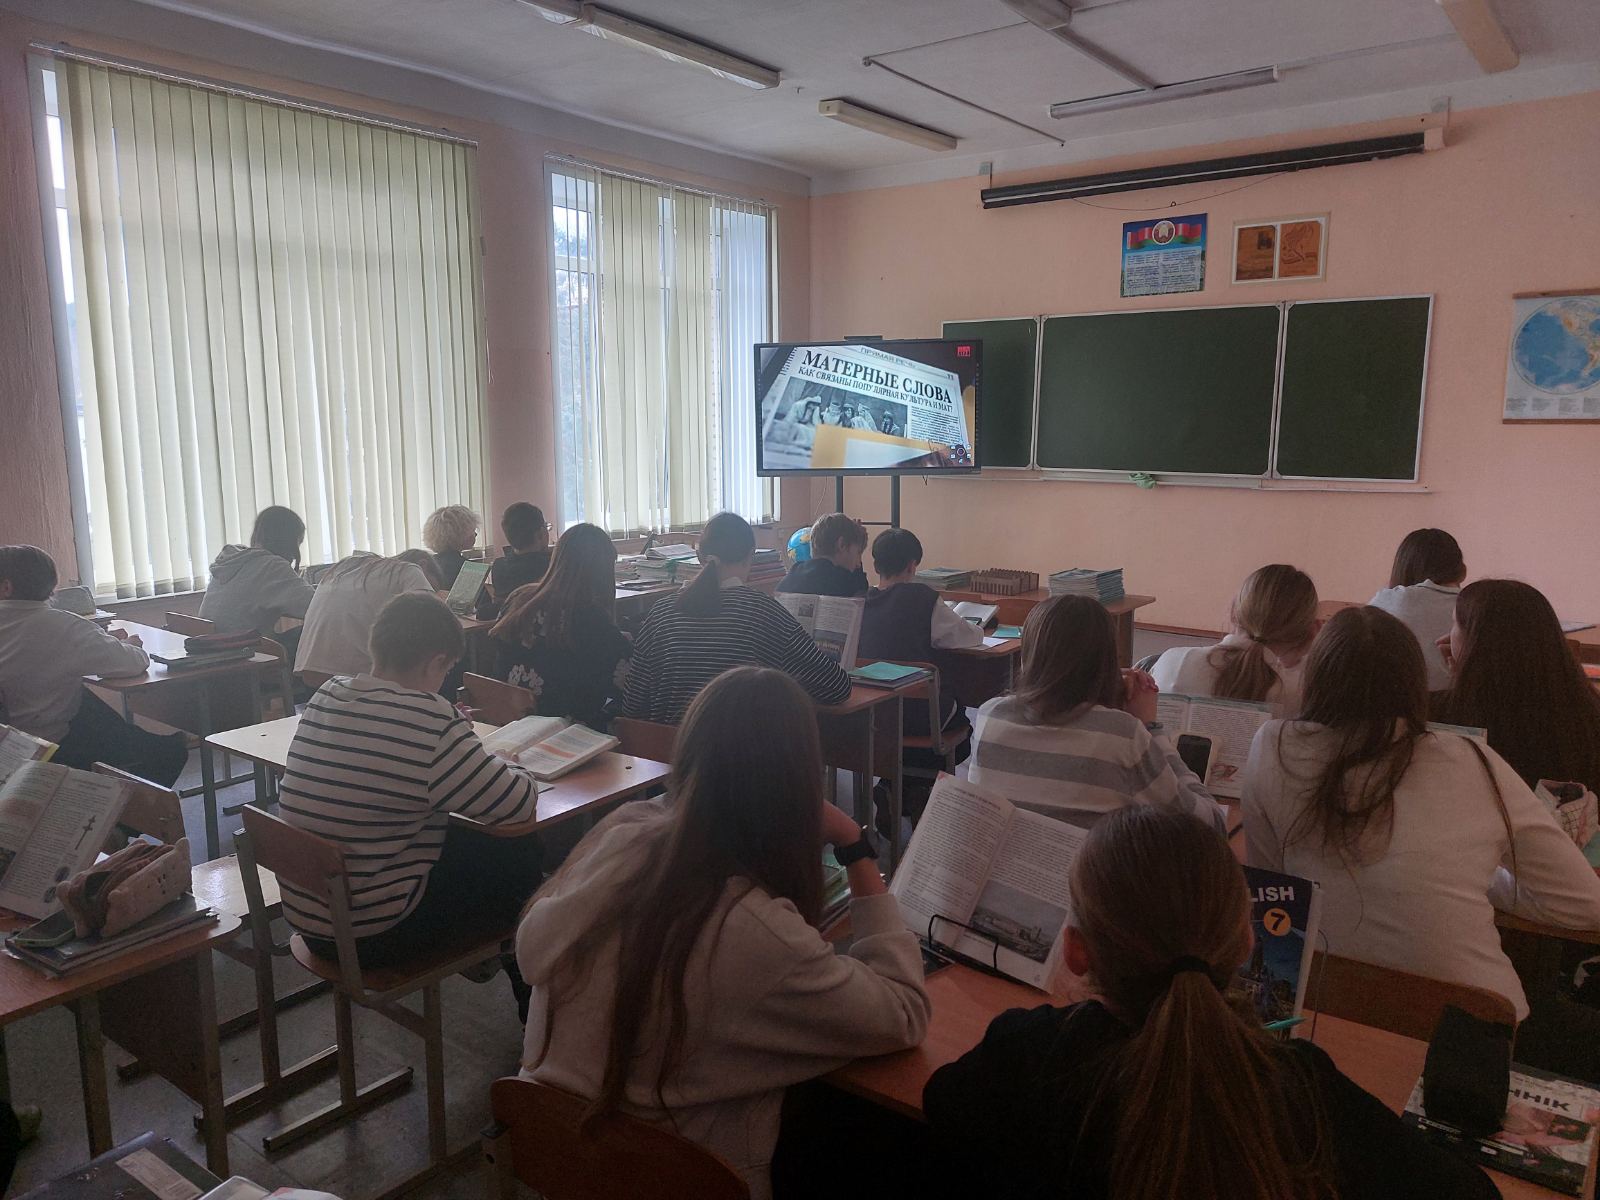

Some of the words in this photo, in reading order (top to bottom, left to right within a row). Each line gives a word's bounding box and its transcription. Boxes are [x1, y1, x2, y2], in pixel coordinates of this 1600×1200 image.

[798, 366, 816, 377] КАК
[815, 370, 853, 387] СВЯЗАНЫ
[802, 350, 899, 390] МАТЕРНЫЕ
[902, 377, 953, 404] СЛОВА
[1247, 885, 1295, 903] LISH
[1270, 912, 1286, 931] 7
